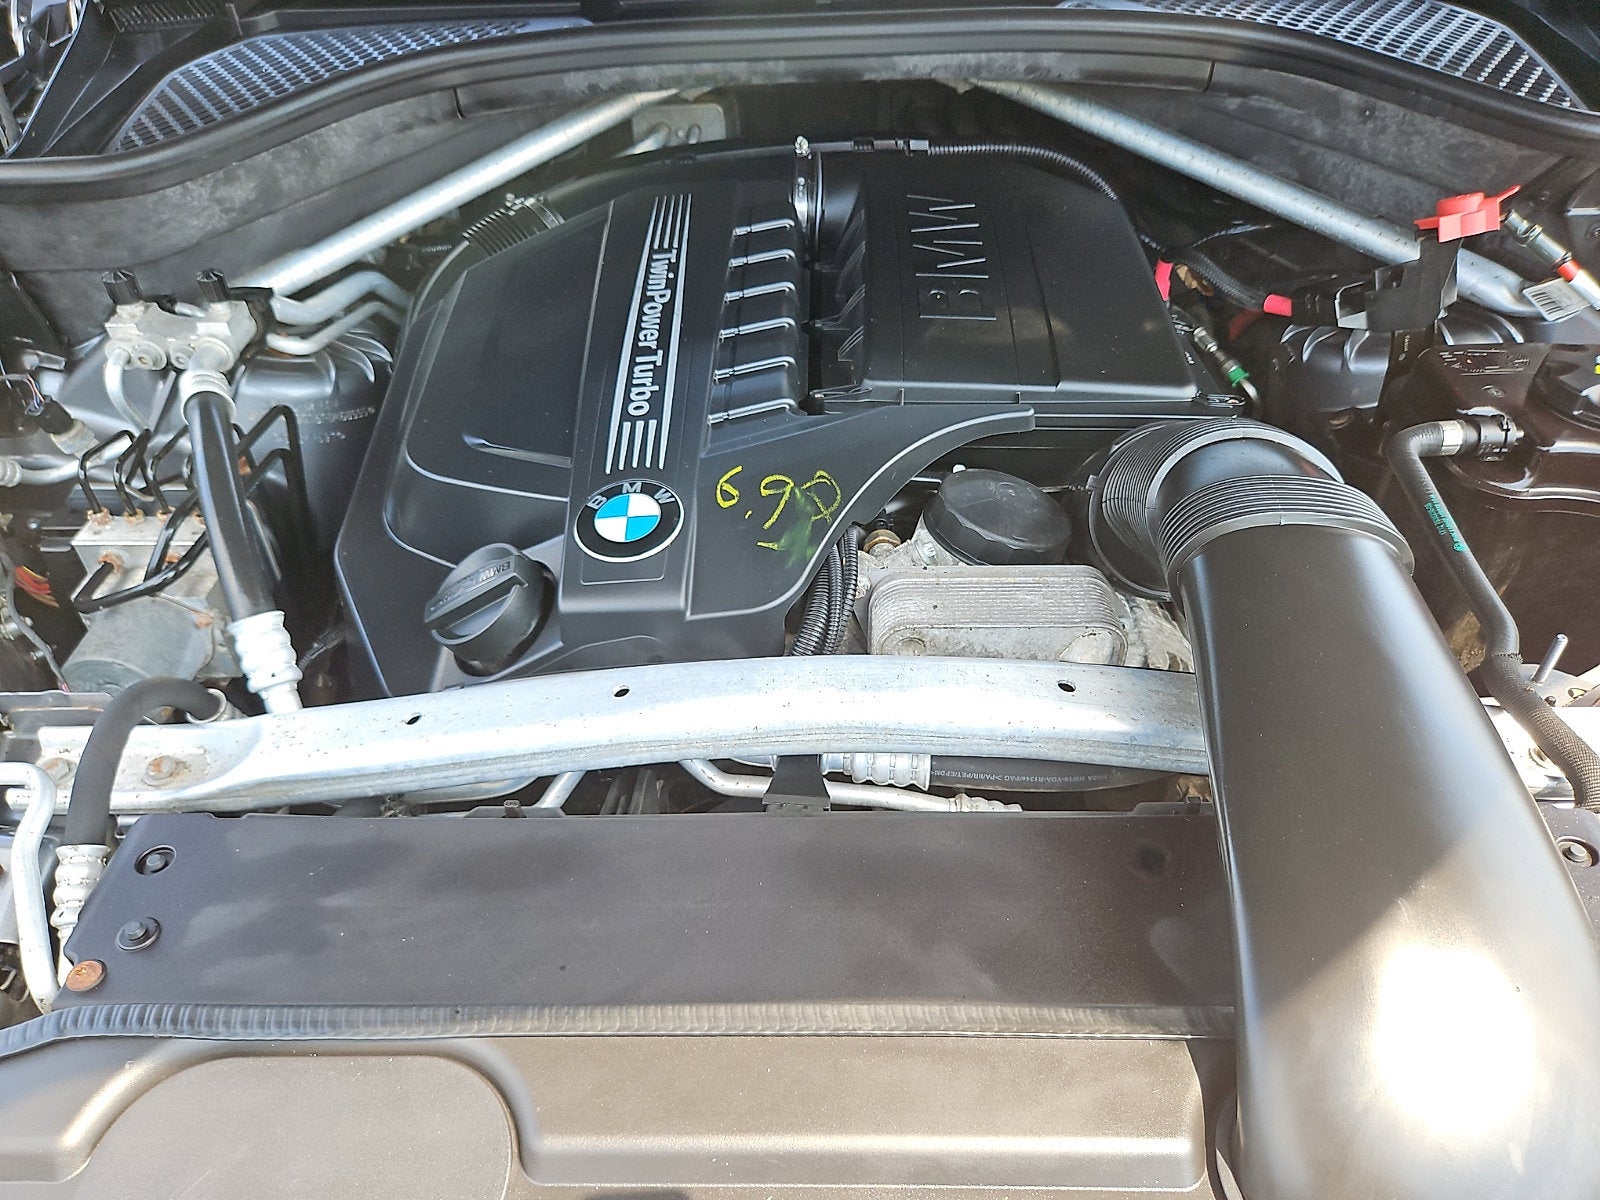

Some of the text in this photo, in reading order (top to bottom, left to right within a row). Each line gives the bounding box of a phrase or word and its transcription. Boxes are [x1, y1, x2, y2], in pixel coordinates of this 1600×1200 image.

[906, 194, 998, 321] BMW
[627, 249, 678, 416] TwinPower Turbo
[586, 482, 676, 510] BMW
